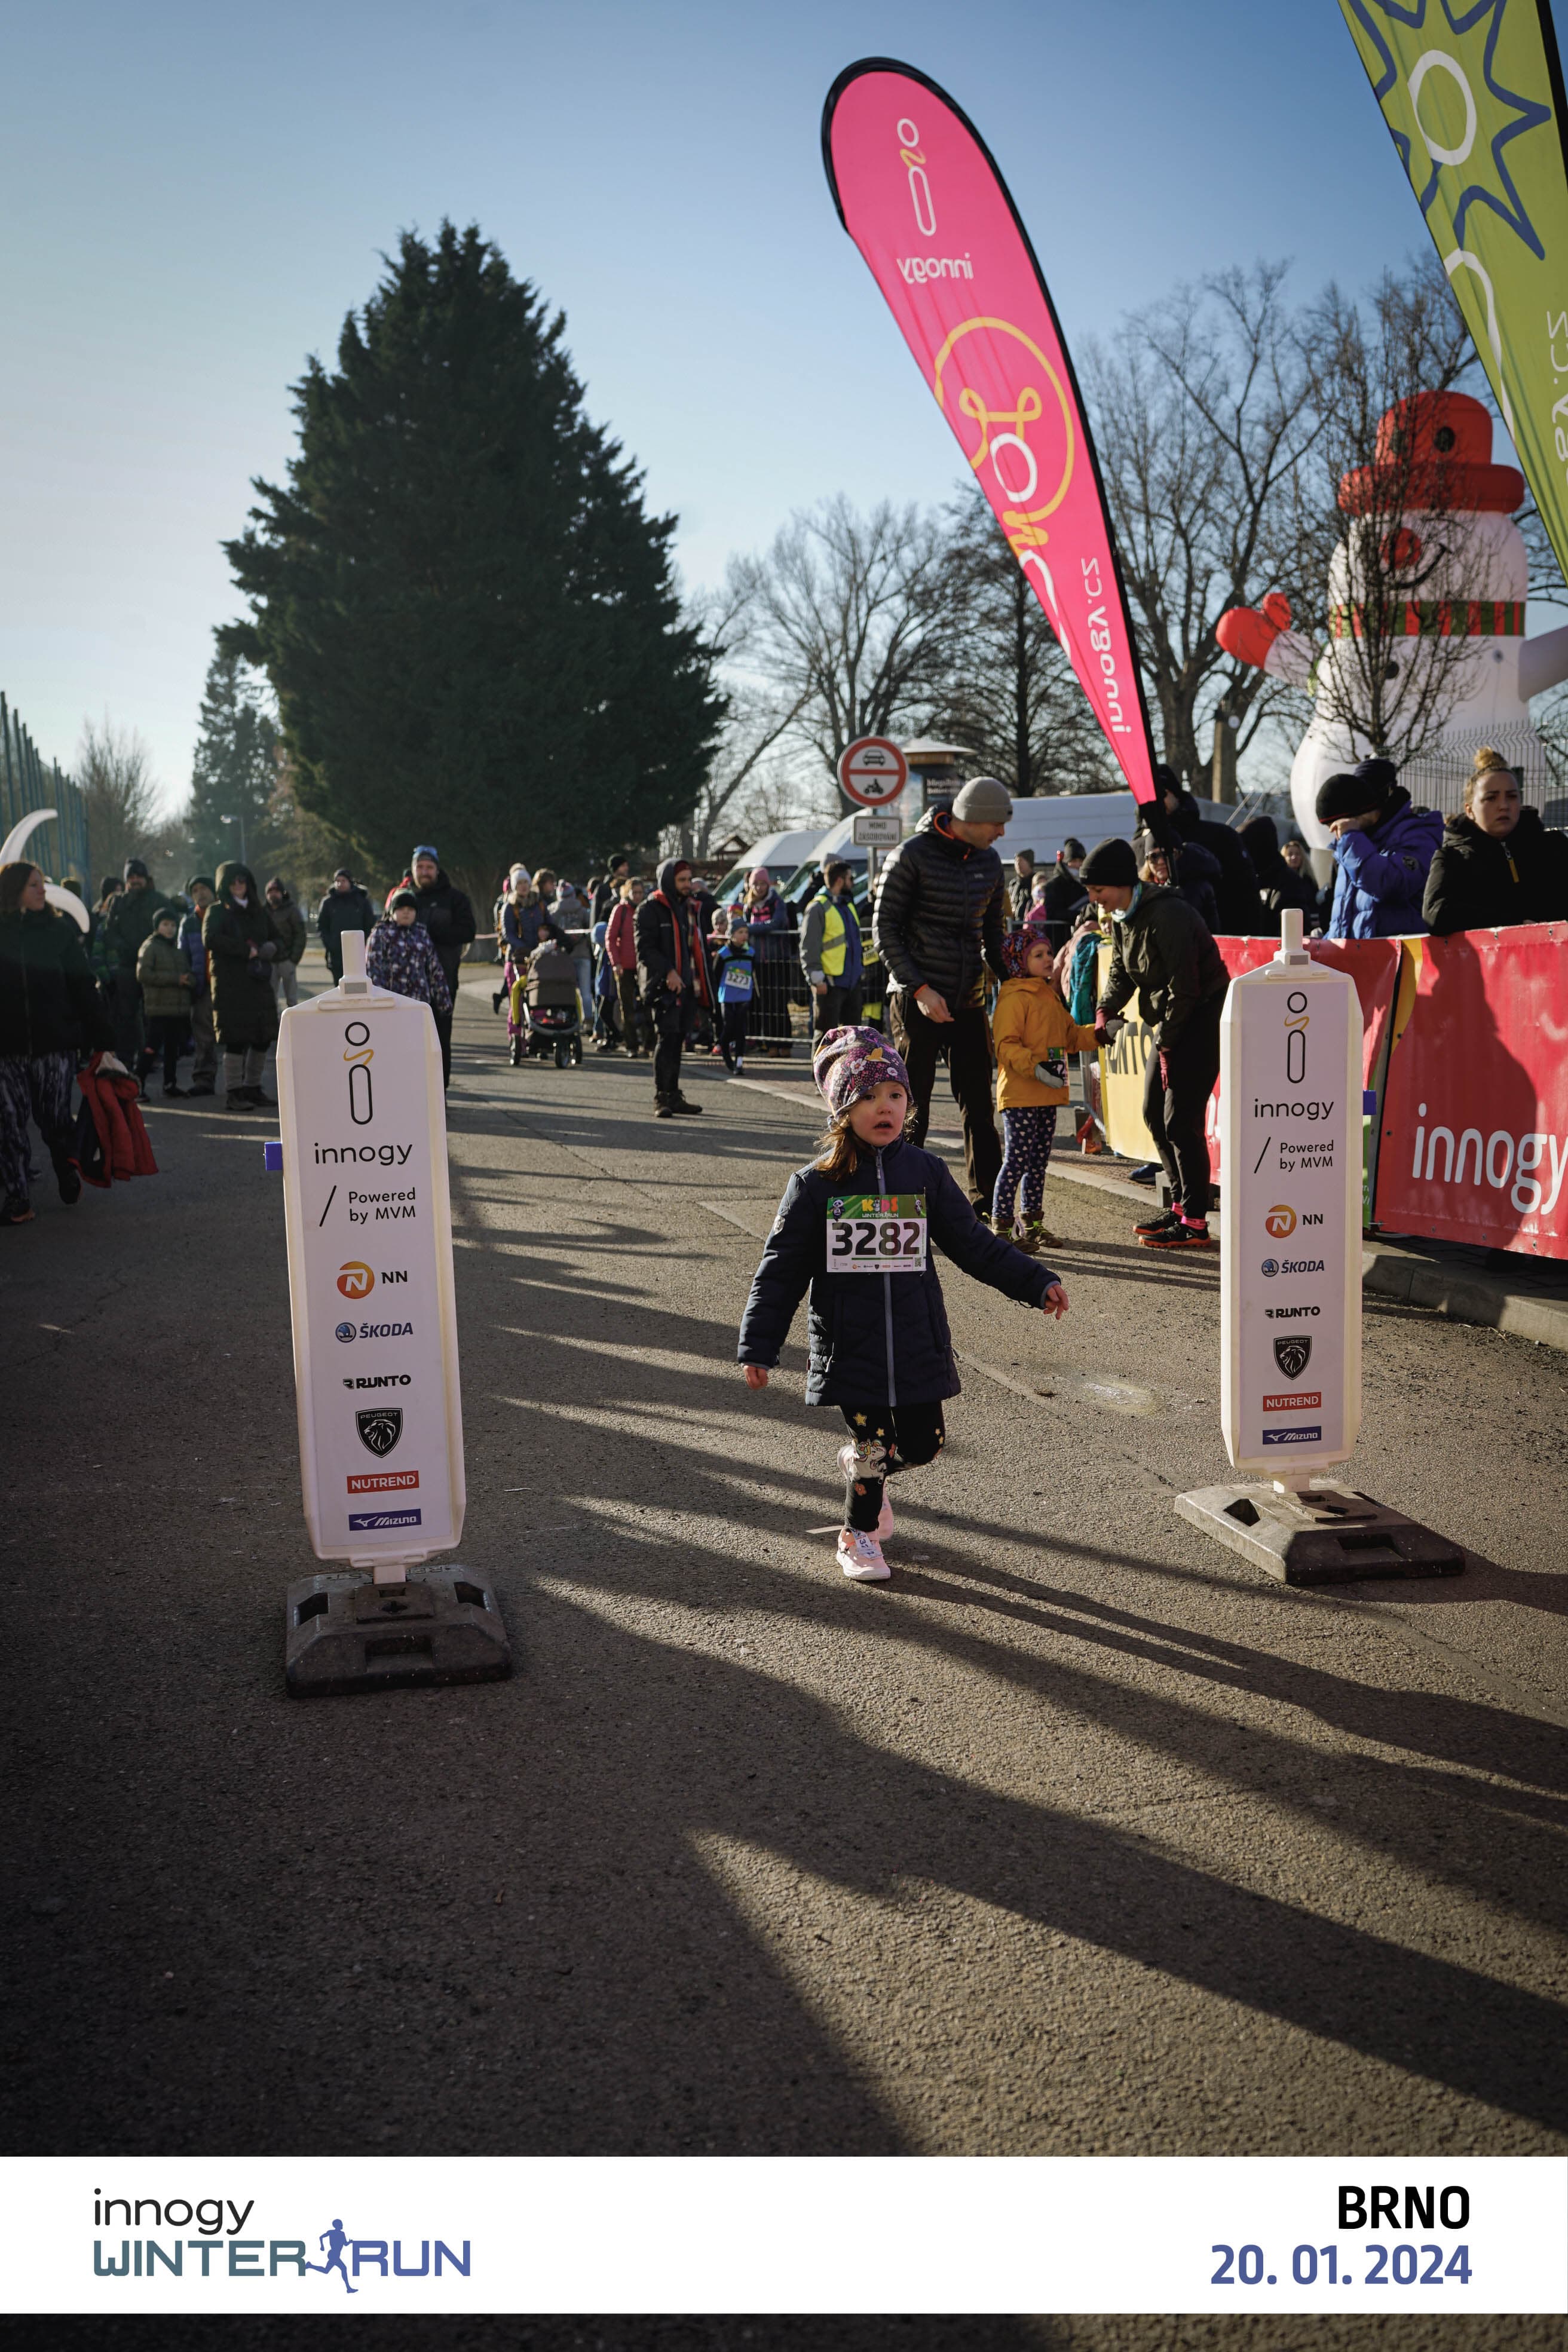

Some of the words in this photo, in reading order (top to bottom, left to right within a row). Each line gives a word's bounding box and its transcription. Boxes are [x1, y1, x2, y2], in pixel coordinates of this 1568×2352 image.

[1105, 1021, 1154, 1074] UNTO
[1254, 1098, 1334, 1120] innogy
[314, 1143, 412, 1166] innogy
[1280, 1140, 1334, 1154] Powered
[1280, 1158, 1296, 1172] by
[1301, 1156, 1333, 1169] MVM
[1412, 1102, 1568, 1215] innogy
[349, 1187, 416, 1204] Powered
[350, 1209, 368, 1224] by
[375, 1206, 416, 1220] MVM
[1302, 1214, 1324, 1226] NN
[832, 1221, 920, 1255] 3282
[1281, 1260, 1325, 1273] ŠKODA
[381, 1270, 408, 1284] NN
[1275, 1306, 1321, 1318] RUNTO
[359, 1322, 414, 1339] ŠKODA
[356, 1374, 412, 1389] RUNTO
[1266, 1396, 1319, 1408] NUTREND
[351, 1475, 416, 1490] NUTREND
